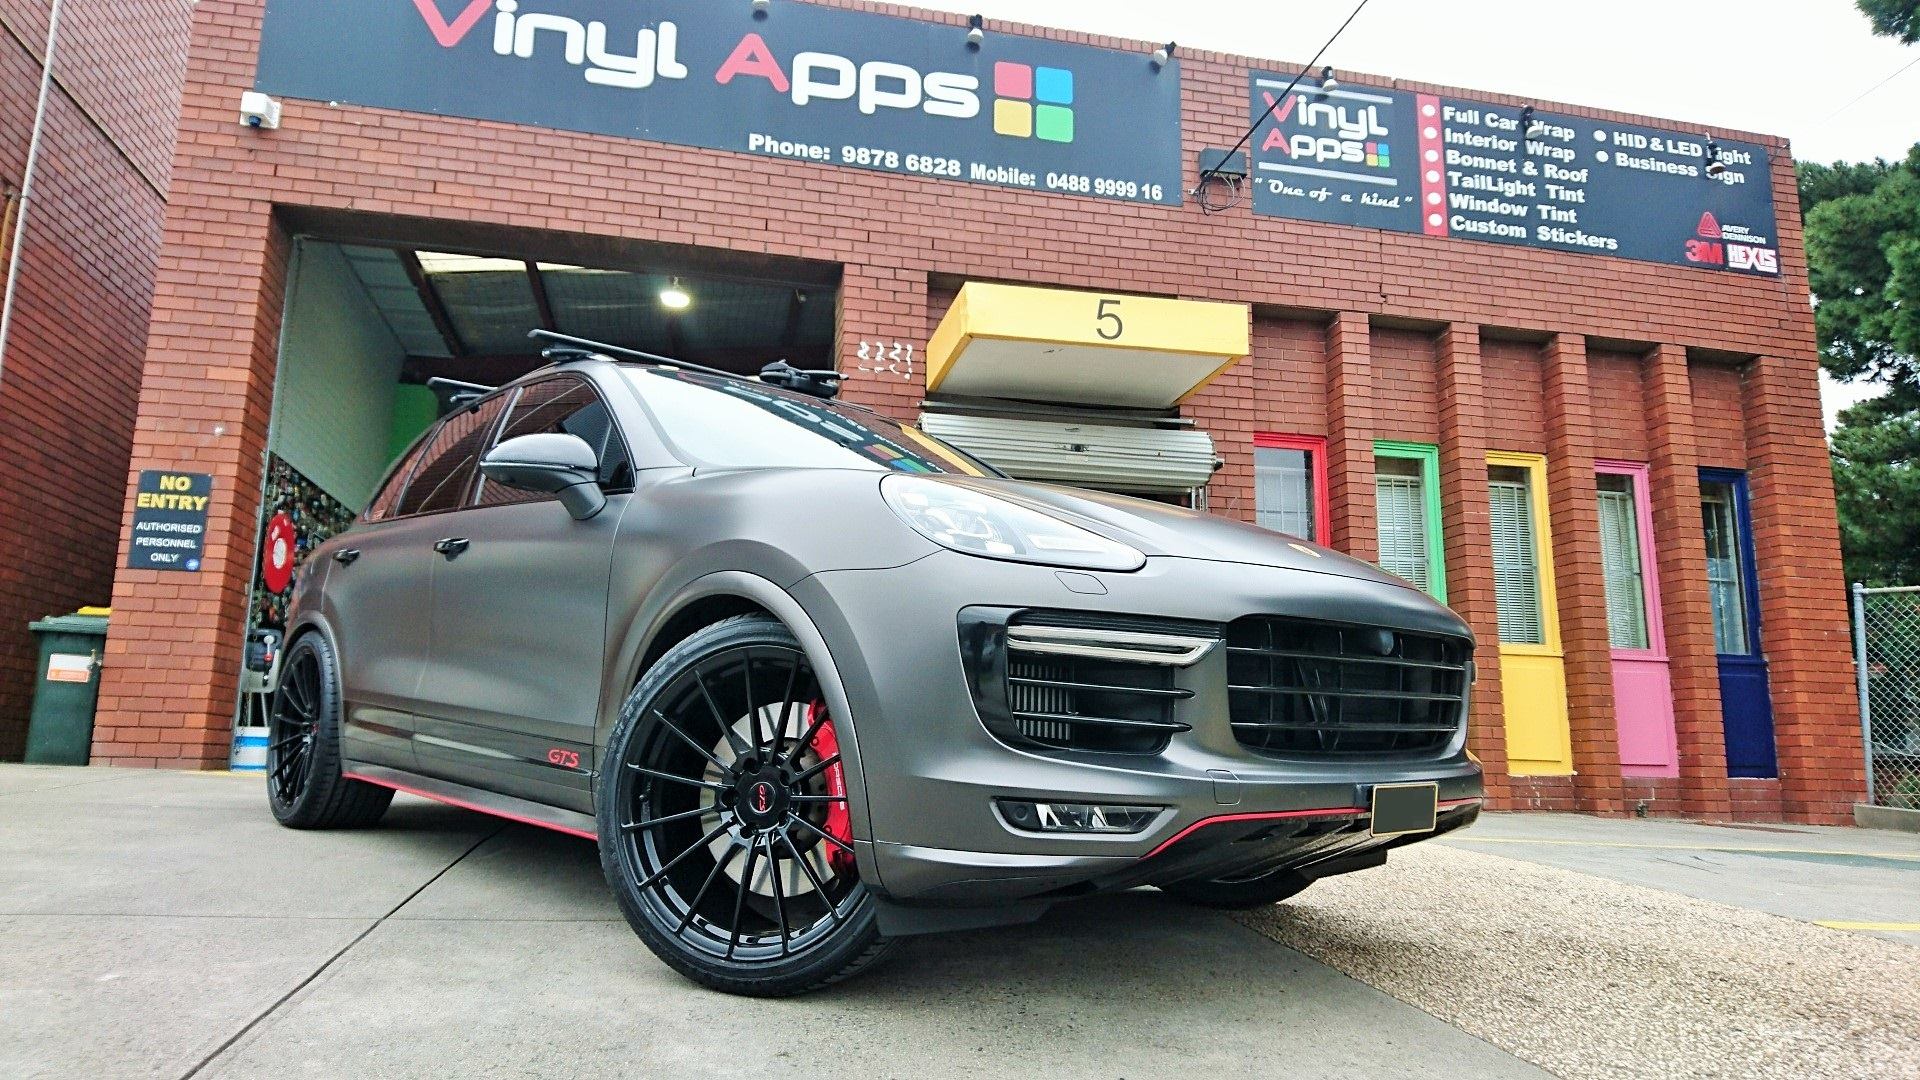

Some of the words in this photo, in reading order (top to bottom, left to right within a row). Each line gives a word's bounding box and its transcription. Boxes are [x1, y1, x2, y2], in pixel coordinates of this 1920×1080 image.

[412, 0, 688, 89] Vinyl
[715, 33, 981, 118] Apps
[1262, 90, 1389, 141] Vinyl
[1443, 105, 1480, 126] Full
[1484, 112, 1519, 131] Car
[1262, 127, 1365, 163] Apps
[1444, 127, 1518, 152] Interior
[1525, 139, 1576, 163] Wrap
[1613, 131, 1648, 149] HID
[1649, 137, 1664, 152] &
[1666, 139, 1703, 157] LED
[748, 133, 831, 161] Phone:
[841, 145, 899, 169] 9878
[905, 154, 961, 177] 6828
[970, 162, 1036, 187] Mobile:
[1046, 172, 1090, 193] 0488
[1094, 177, 1137, 198] 9999
[1141, 183, 1163, 201] 16
[1445, 149, 1517, 174] Bonnet
[1522, 160, 1539, 177] &
[1543, 163, 1589, 183] Roof
[1614, 151, 1698, 177] Business
[1268, 179, 1305, 197] One
[1308, 187, 1333, 202] of
[1340, 194, 1353, 203] a
[1360, 192, 1400, 209] kind
[1447, 170, 1536, 197] TailLight
[1545, 183, 1586, 203] Tint
[1449, 192, 1528, 217] Window
[1536, 204, 1577, 223] Tint
[1450, 214, 1527, 239] Custom
[1536, 225, 1618, 250] Stickers
[1721, 224, 1750, 235] AVERY
[1722, 232, 1767, 245] DENNISON
[1685, 239, 1724, 265] 3M
[1727, 243, 1778, 273] HEXIS
[1095, 298, 1123, 341] 5
[160, 475, 192, 491] NO
[137, 492, 208, 511] ENTRY
[136, 521, 202, 534] AUTHORISED
[135, 537, 198, 549] PERSONNEL
[150, 552, 179, 562] ONLY
[548, 749, 579, 767] GTS
